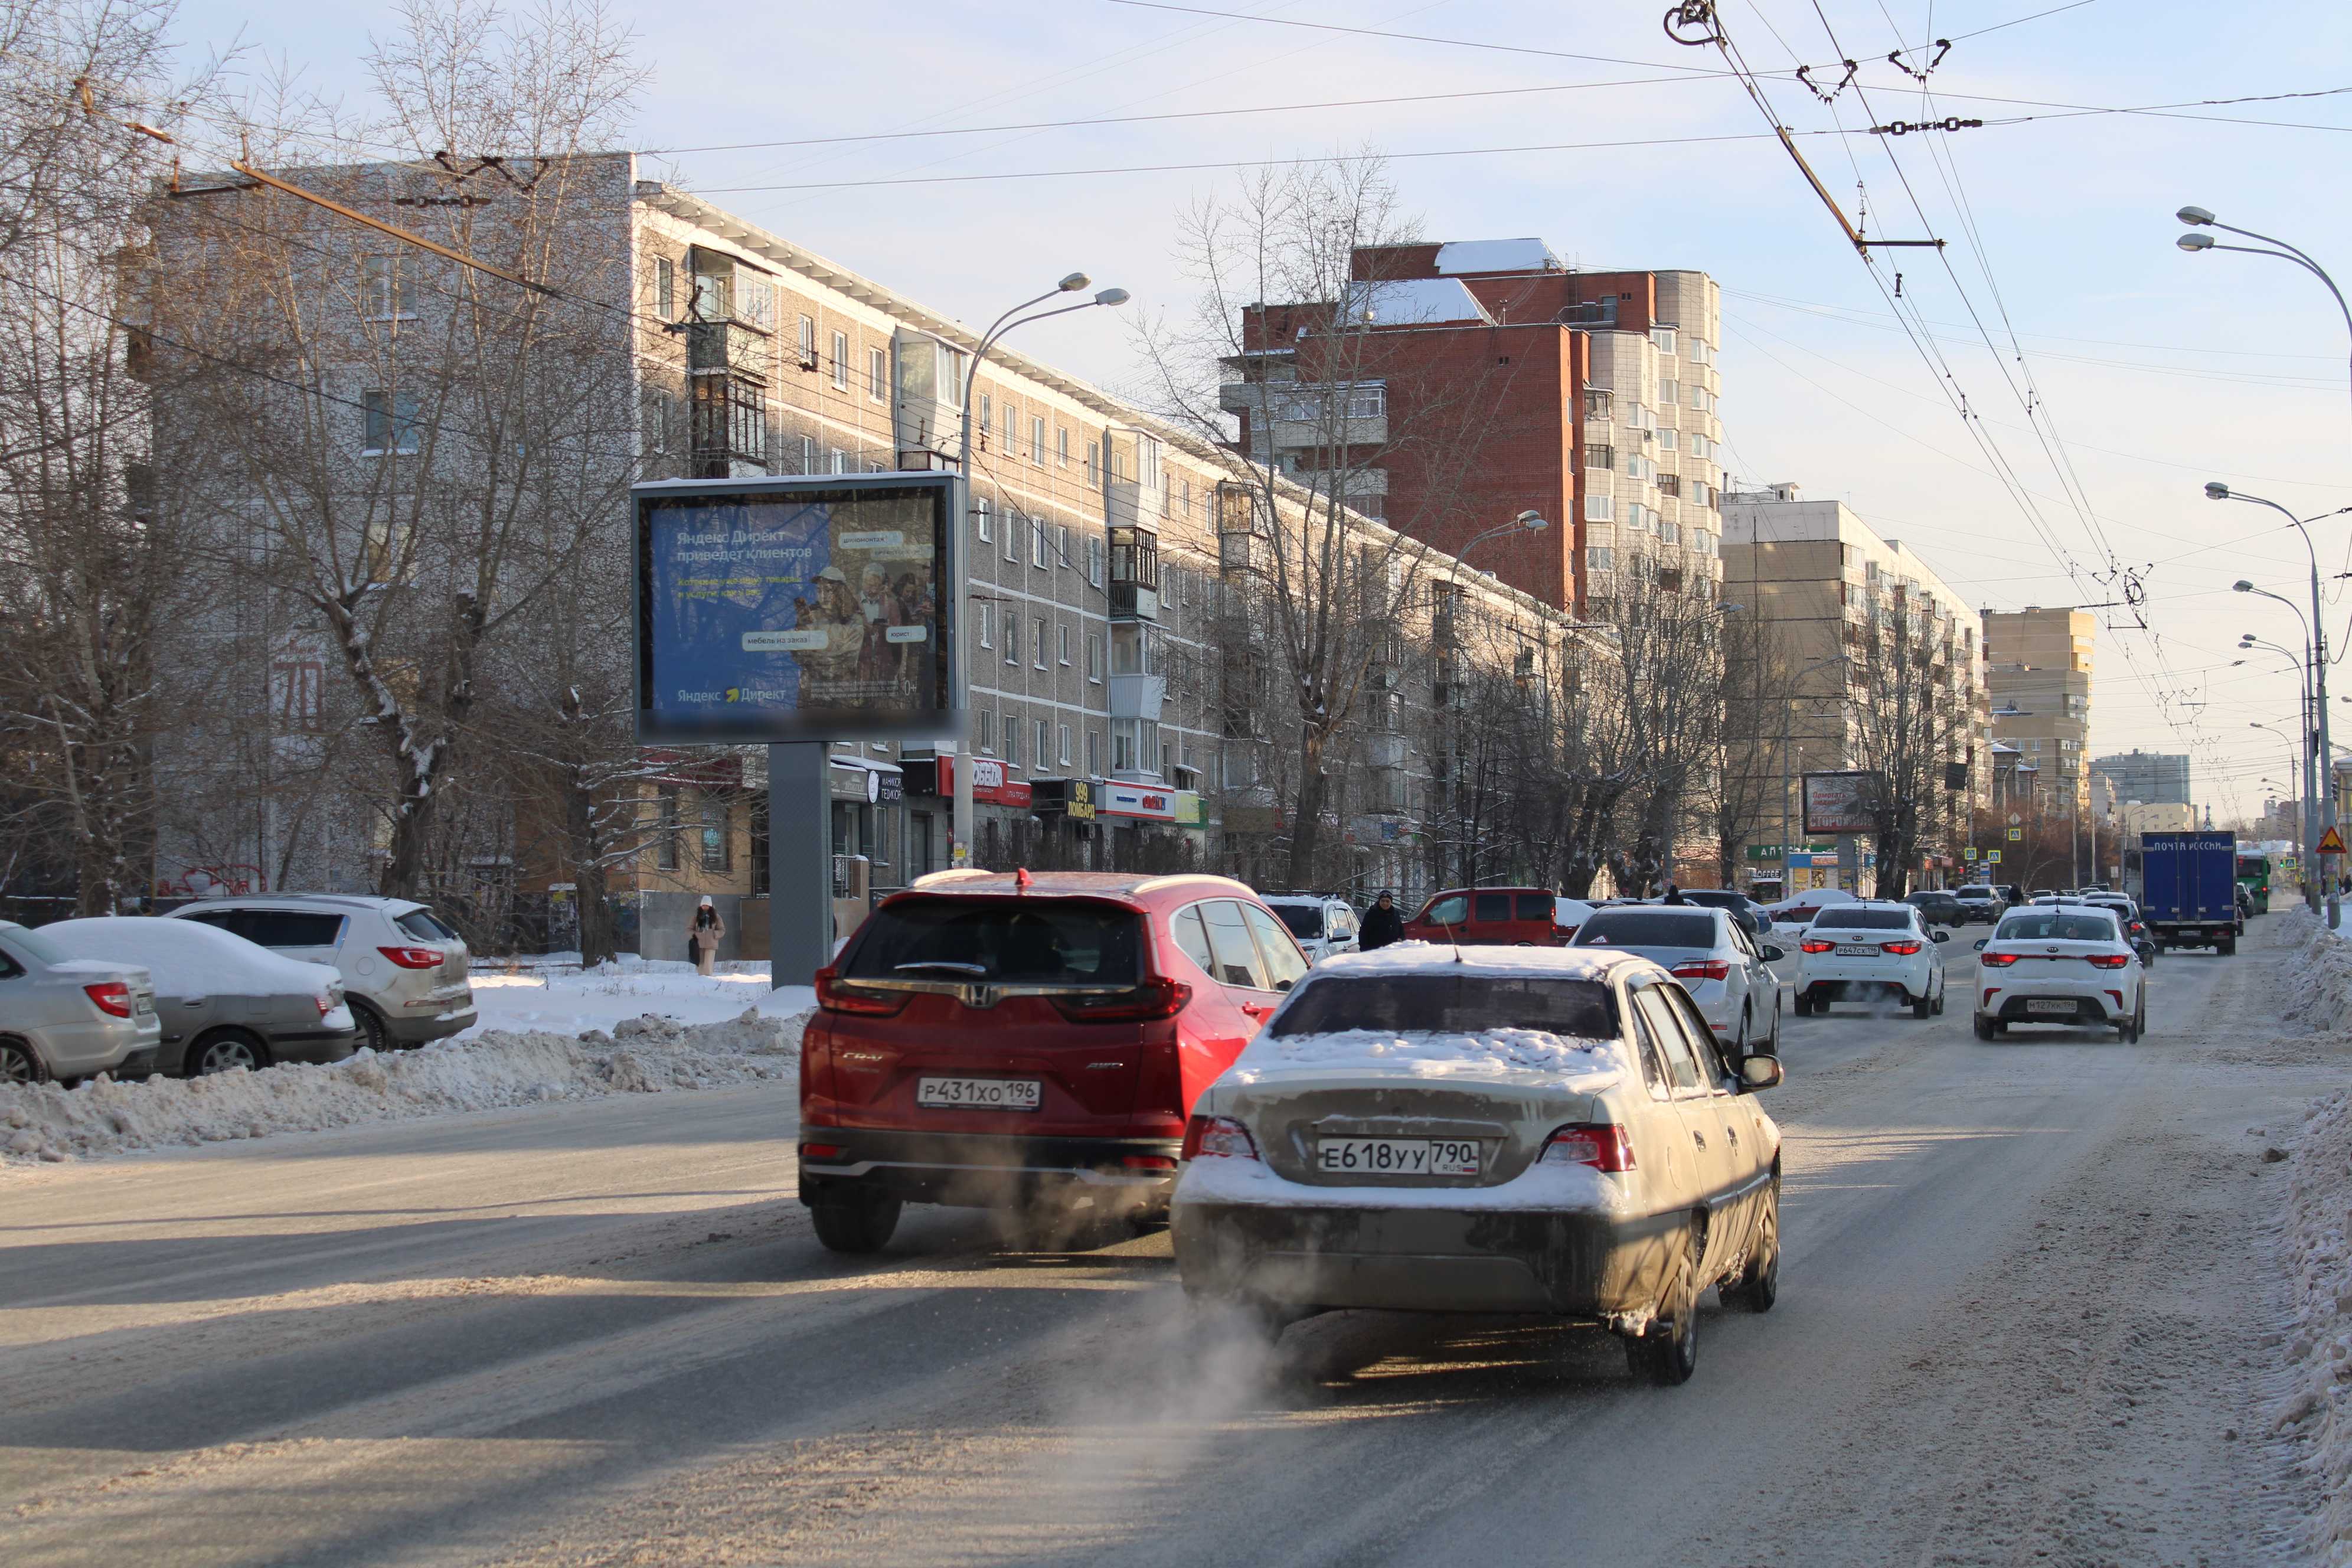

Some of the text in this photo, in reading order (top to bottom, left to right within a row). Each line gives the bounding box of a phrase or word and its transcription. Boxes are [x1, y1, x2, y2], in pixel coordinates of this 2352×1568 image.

[677, 531, 785, 545] Яндекс Директ
[747, 636, 775, 645] мебель
[904, 680, 917, 695] 0+
[678, 688, 786, 703] Яндекс Директ
[882, 777, 901, 787] МАНИКЮР
[881, 789, 901, 799] ПЕДИКЮР
[1076, 782, 1088, 803] 999
[1068, 801, 1095, 821] ЛОМБАРД
[2155, 842, 2222, 851] ПОЧТА РОССИИ
[925, 1082, 1035, 1102] Р431ХО 196
[1325, 1142, 1472, 1170] Е618УУ 790
